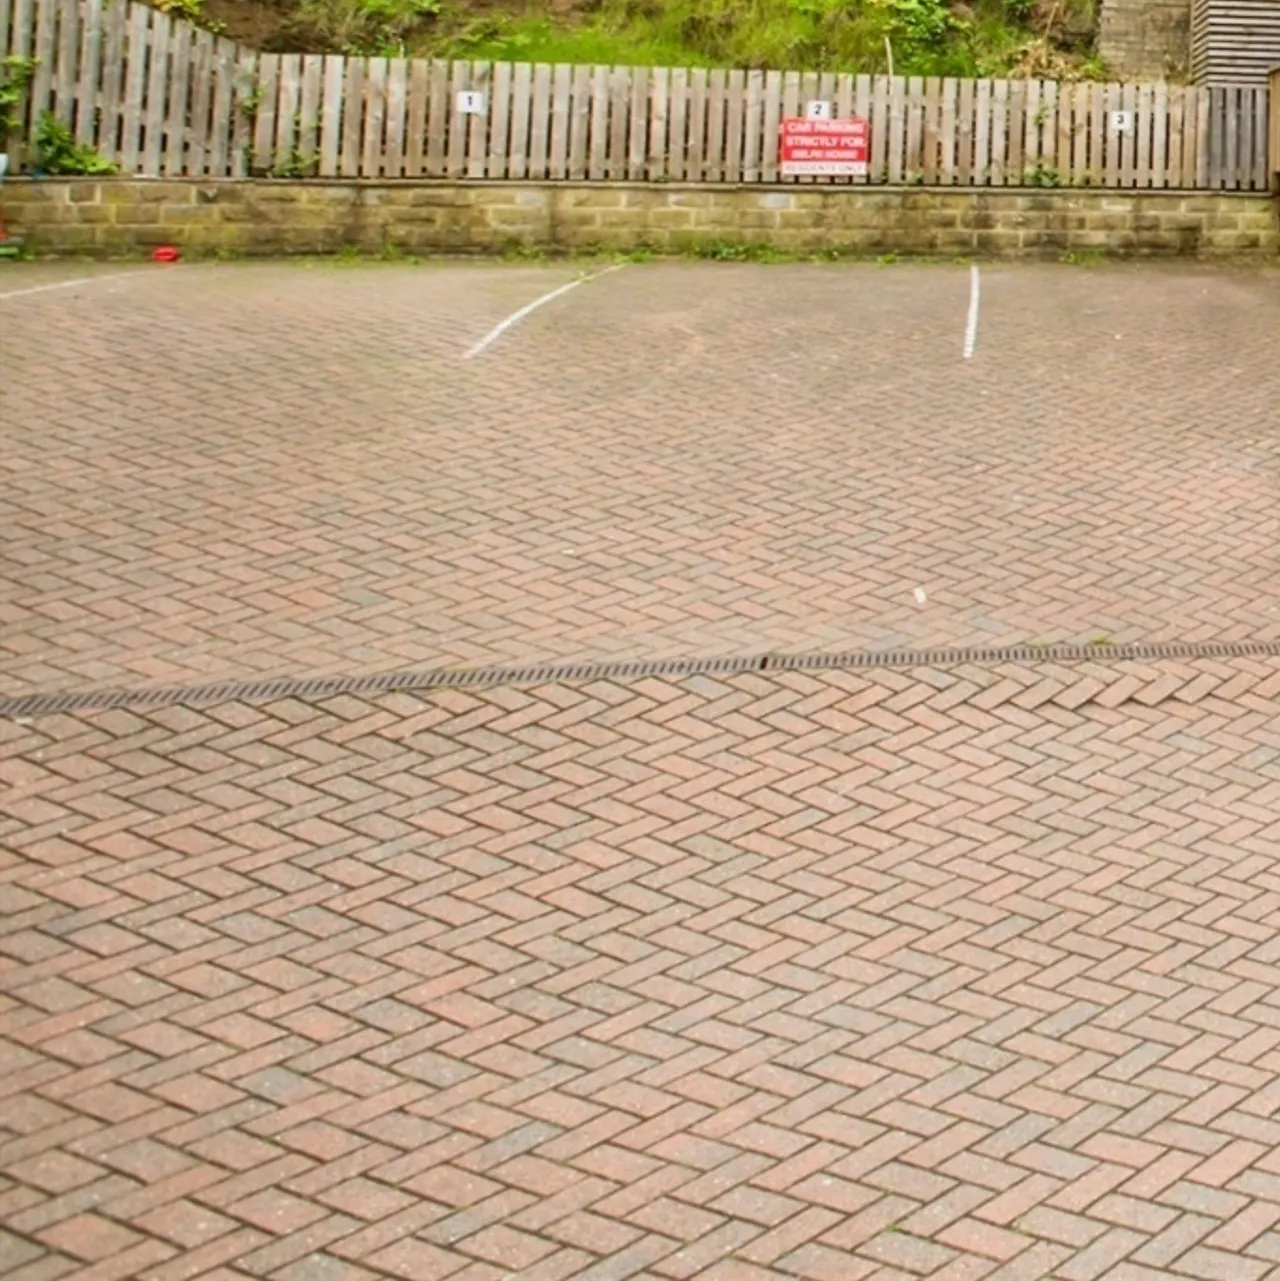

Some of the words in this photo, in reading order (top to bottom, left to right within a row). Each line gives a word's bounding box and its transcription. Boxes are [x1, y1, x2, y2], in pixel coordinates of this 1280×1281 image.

[814, 103, 823, 116] 2
[1117, 114, 1125, 125] 3
[787, 122, 812, 133] CAR
[814, 122, 864, 133] PARKING
[785, 135, 839, 147] STRICTLY
